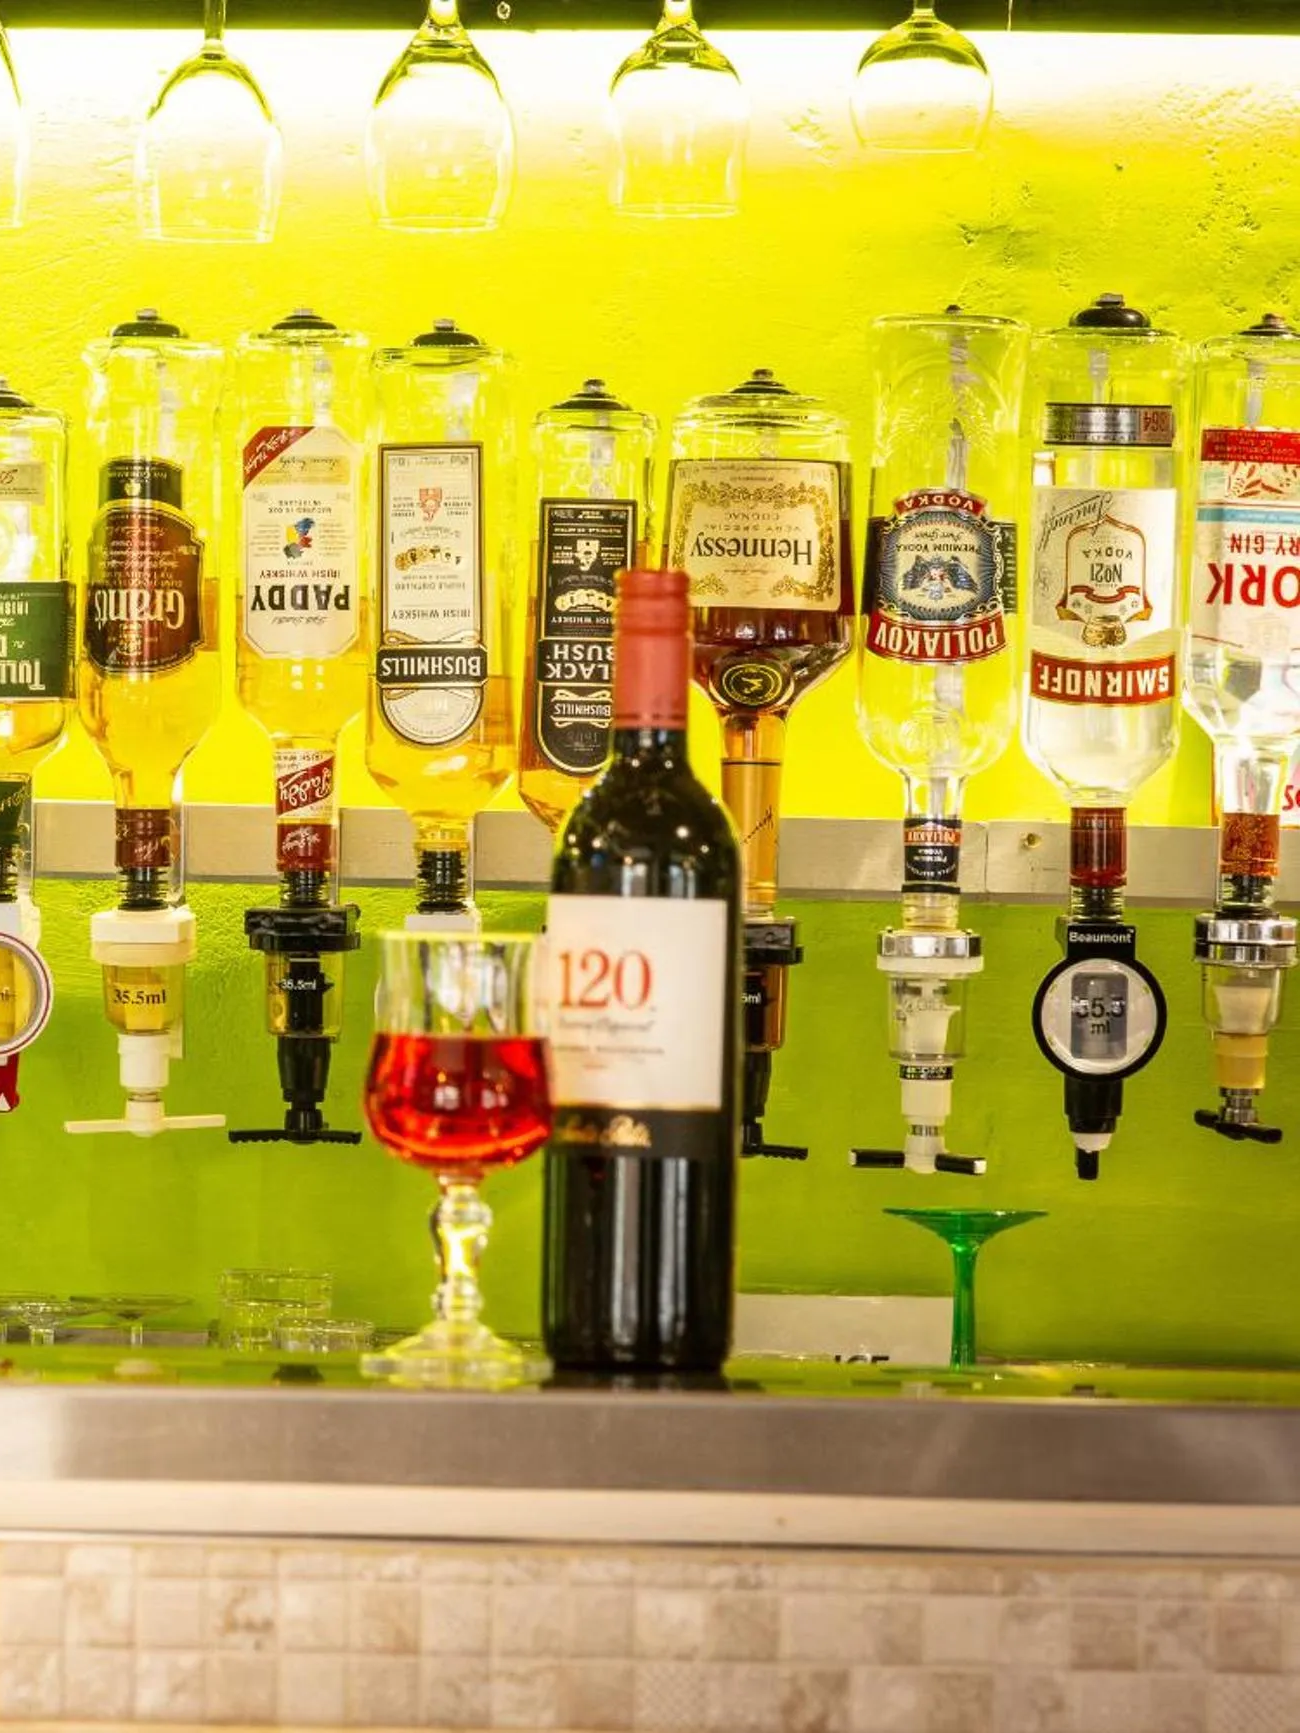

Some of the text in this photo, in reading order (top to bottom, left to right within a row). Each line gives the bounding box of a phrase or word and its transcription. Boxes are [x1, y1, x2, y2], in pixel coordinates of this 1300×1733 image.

[903, 494, 975, 508] VODKA
[690, 532, 813, 566] Hennessy
[895, 543, 981, 552] PREMIUM VODKA
[1230, 533, 1300, 556] RY GIN
[1081, 547, 1133, 560] VODKA
[259, 569, 341, 579] IRISH WHISKEY
[1206, 563, 1300, 608] ORK
[250, 584, 351, 611] PADDY
[390, 609, 471, 619] IRISH WHISKEY
[550, 616, 592, 625] WHISKEY
[874, 621, 998, 657] POLIAKOV
[380, 654, 482, 676] BUSHMILLS
[546, 663, 609, 680] LACK
[1038, 664, 1170, 696] SMIRNOFF
[553, 703, 611, 717] BUSHMILLS
[279, 768, 332, 807] Paddy
[1068, 930, 1132, 943] Beaumont
[280, 979, 317, 991] 35.5ml
[558, 949, 652, 1011] 120
[113, 989, 167, 1005] 35.5ml
[1090, 1019, 1111, 1034] ml
